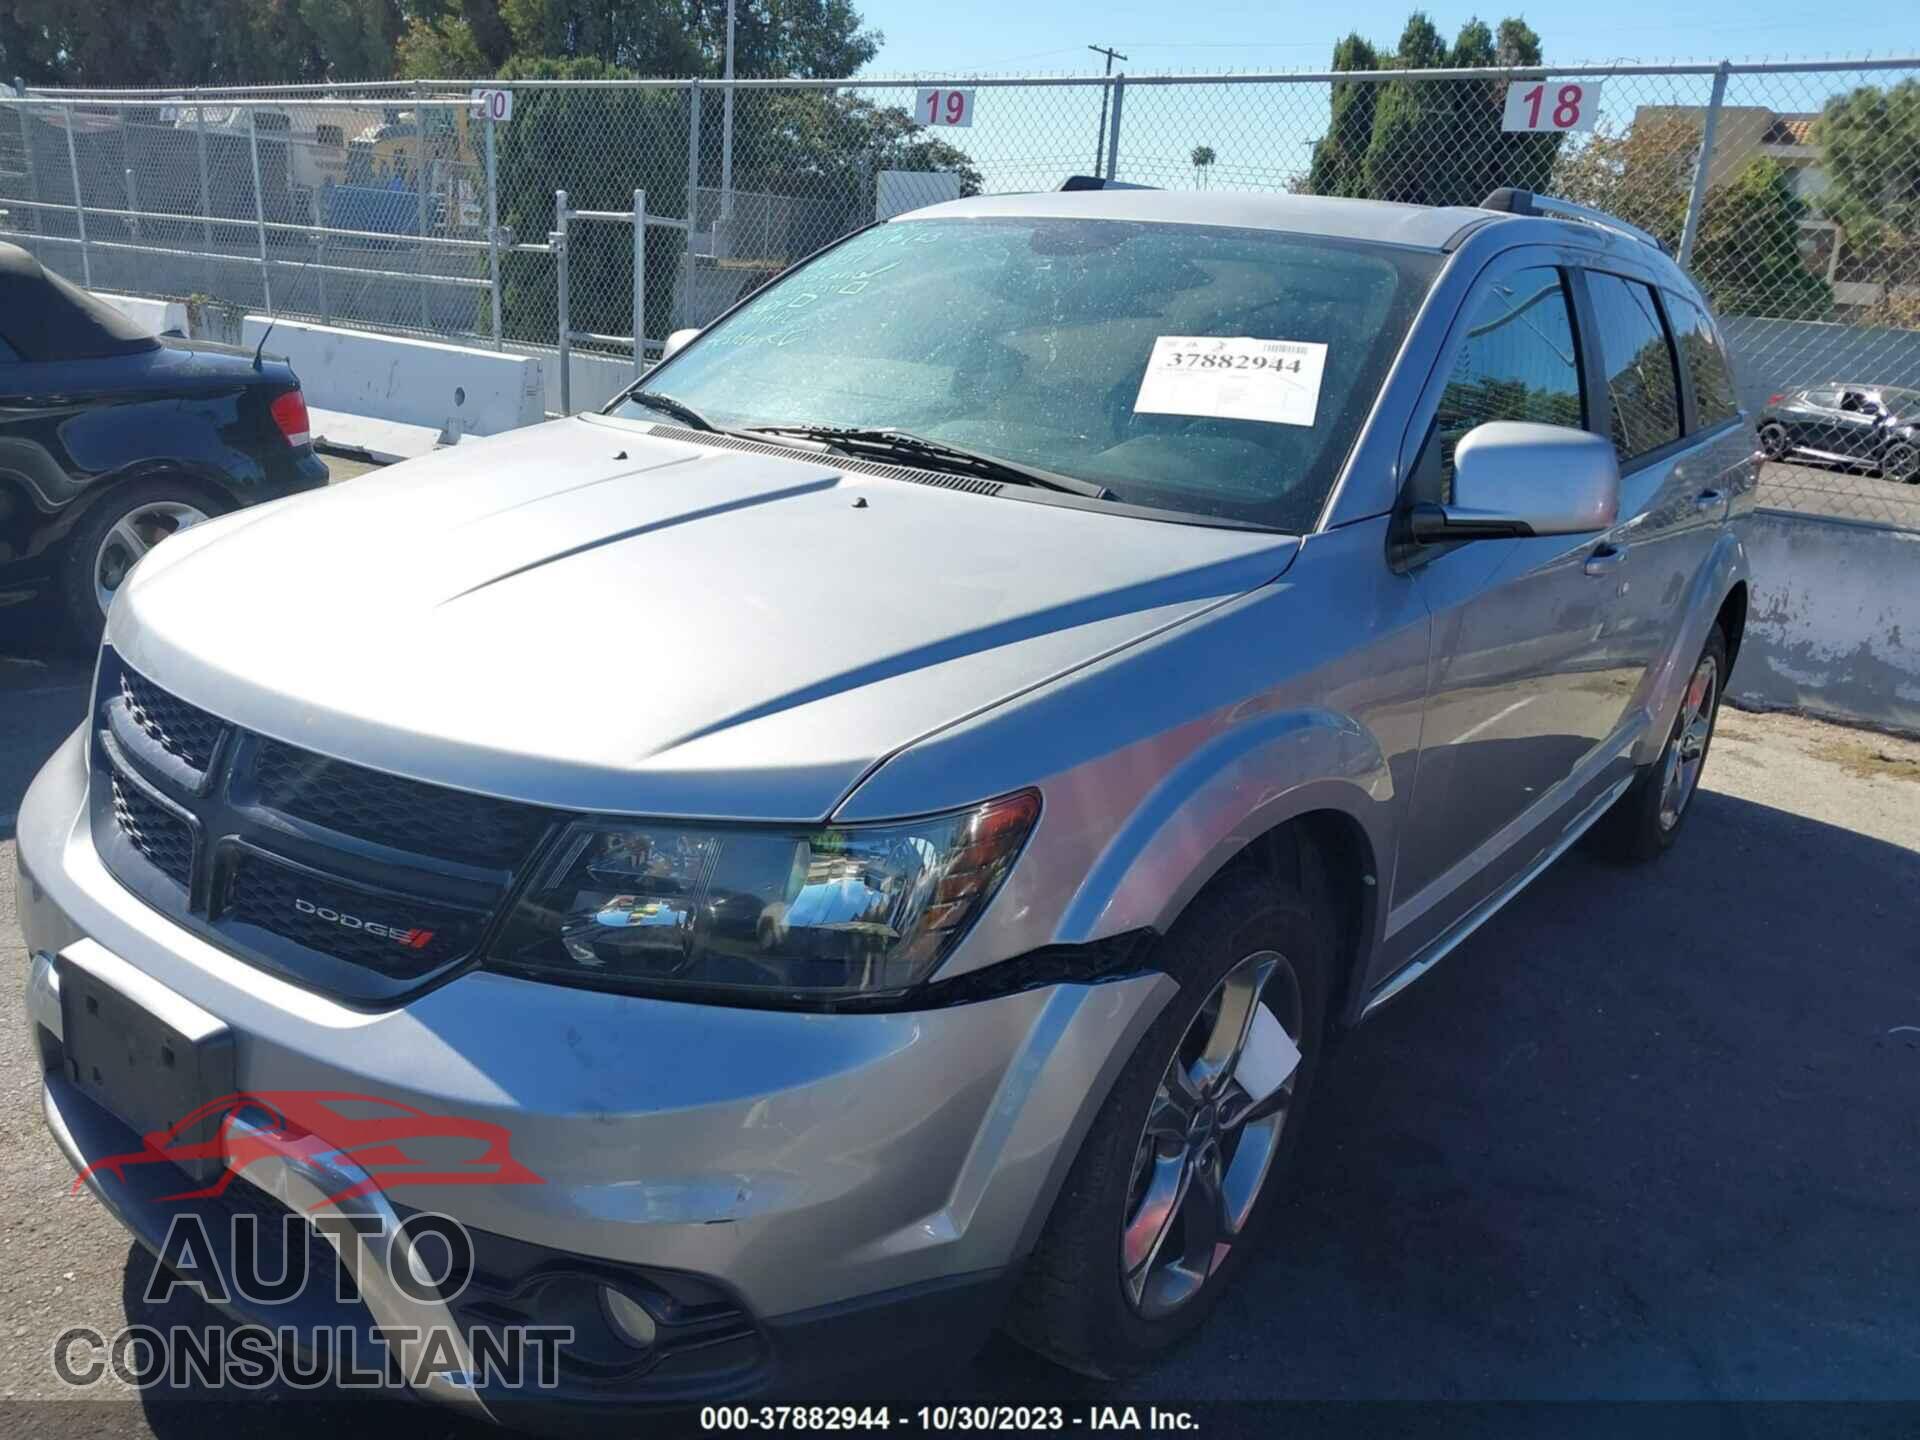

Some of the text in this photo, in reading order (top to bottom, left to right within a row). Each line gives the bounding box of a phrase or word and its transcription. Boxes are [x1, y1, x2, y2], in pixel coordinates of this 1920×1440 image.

[926, 90, 964, 125] 19
[1523, 84, 1583, 128] 18
[1167, 352, 1302, 374] 37882944
[295, 898, 413, 944] DODGE
